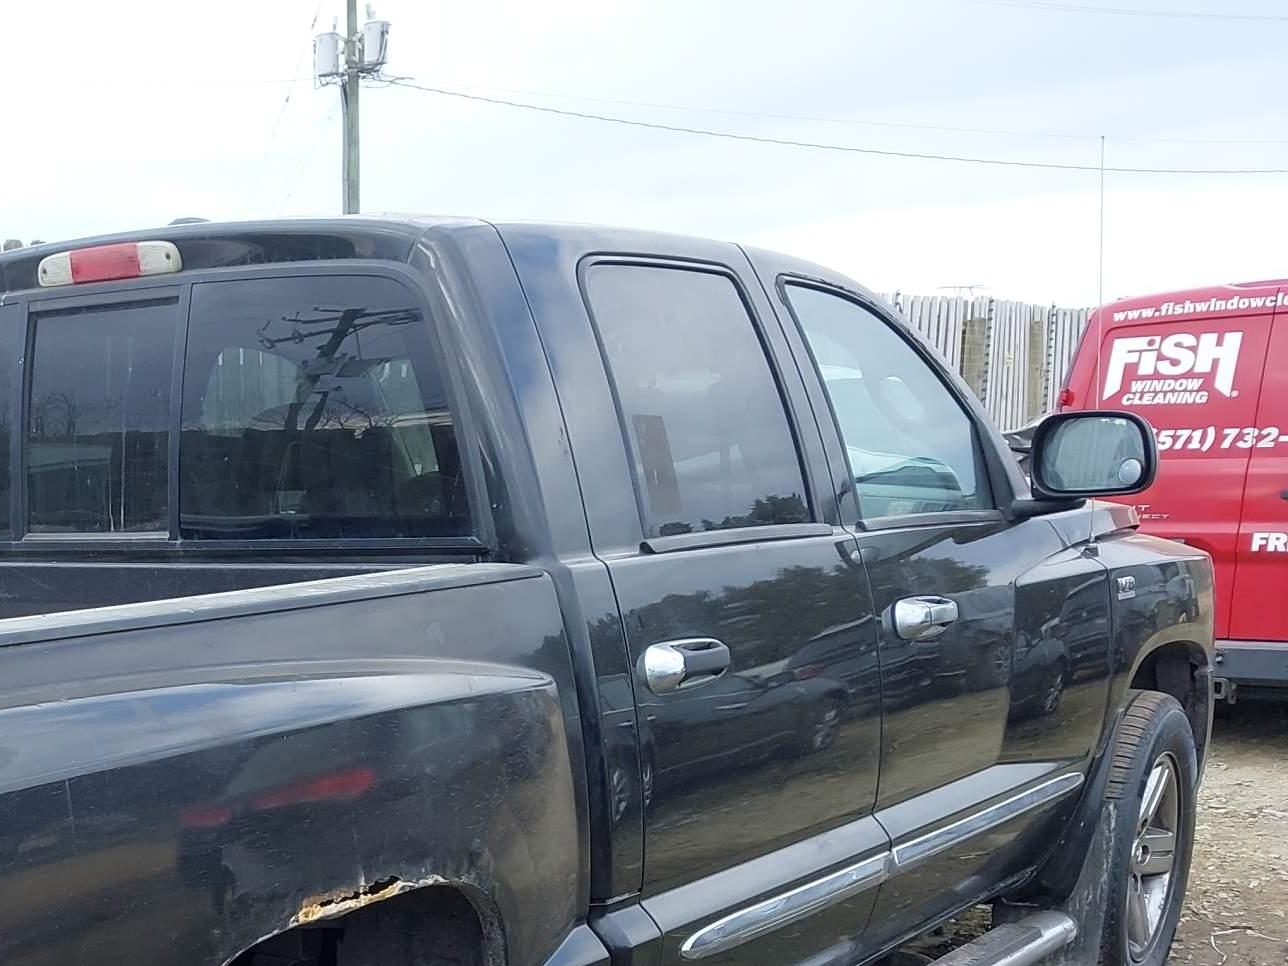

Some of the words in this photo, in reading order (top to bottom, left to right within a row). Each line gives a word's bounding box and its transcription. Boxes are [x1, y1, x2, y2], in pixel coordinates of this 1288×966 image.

[1131, 378, 1204, 393] WINDOW
[1121, 391, 1209, 405] CLEANING
[1251, 532, 1288, 552] FR
